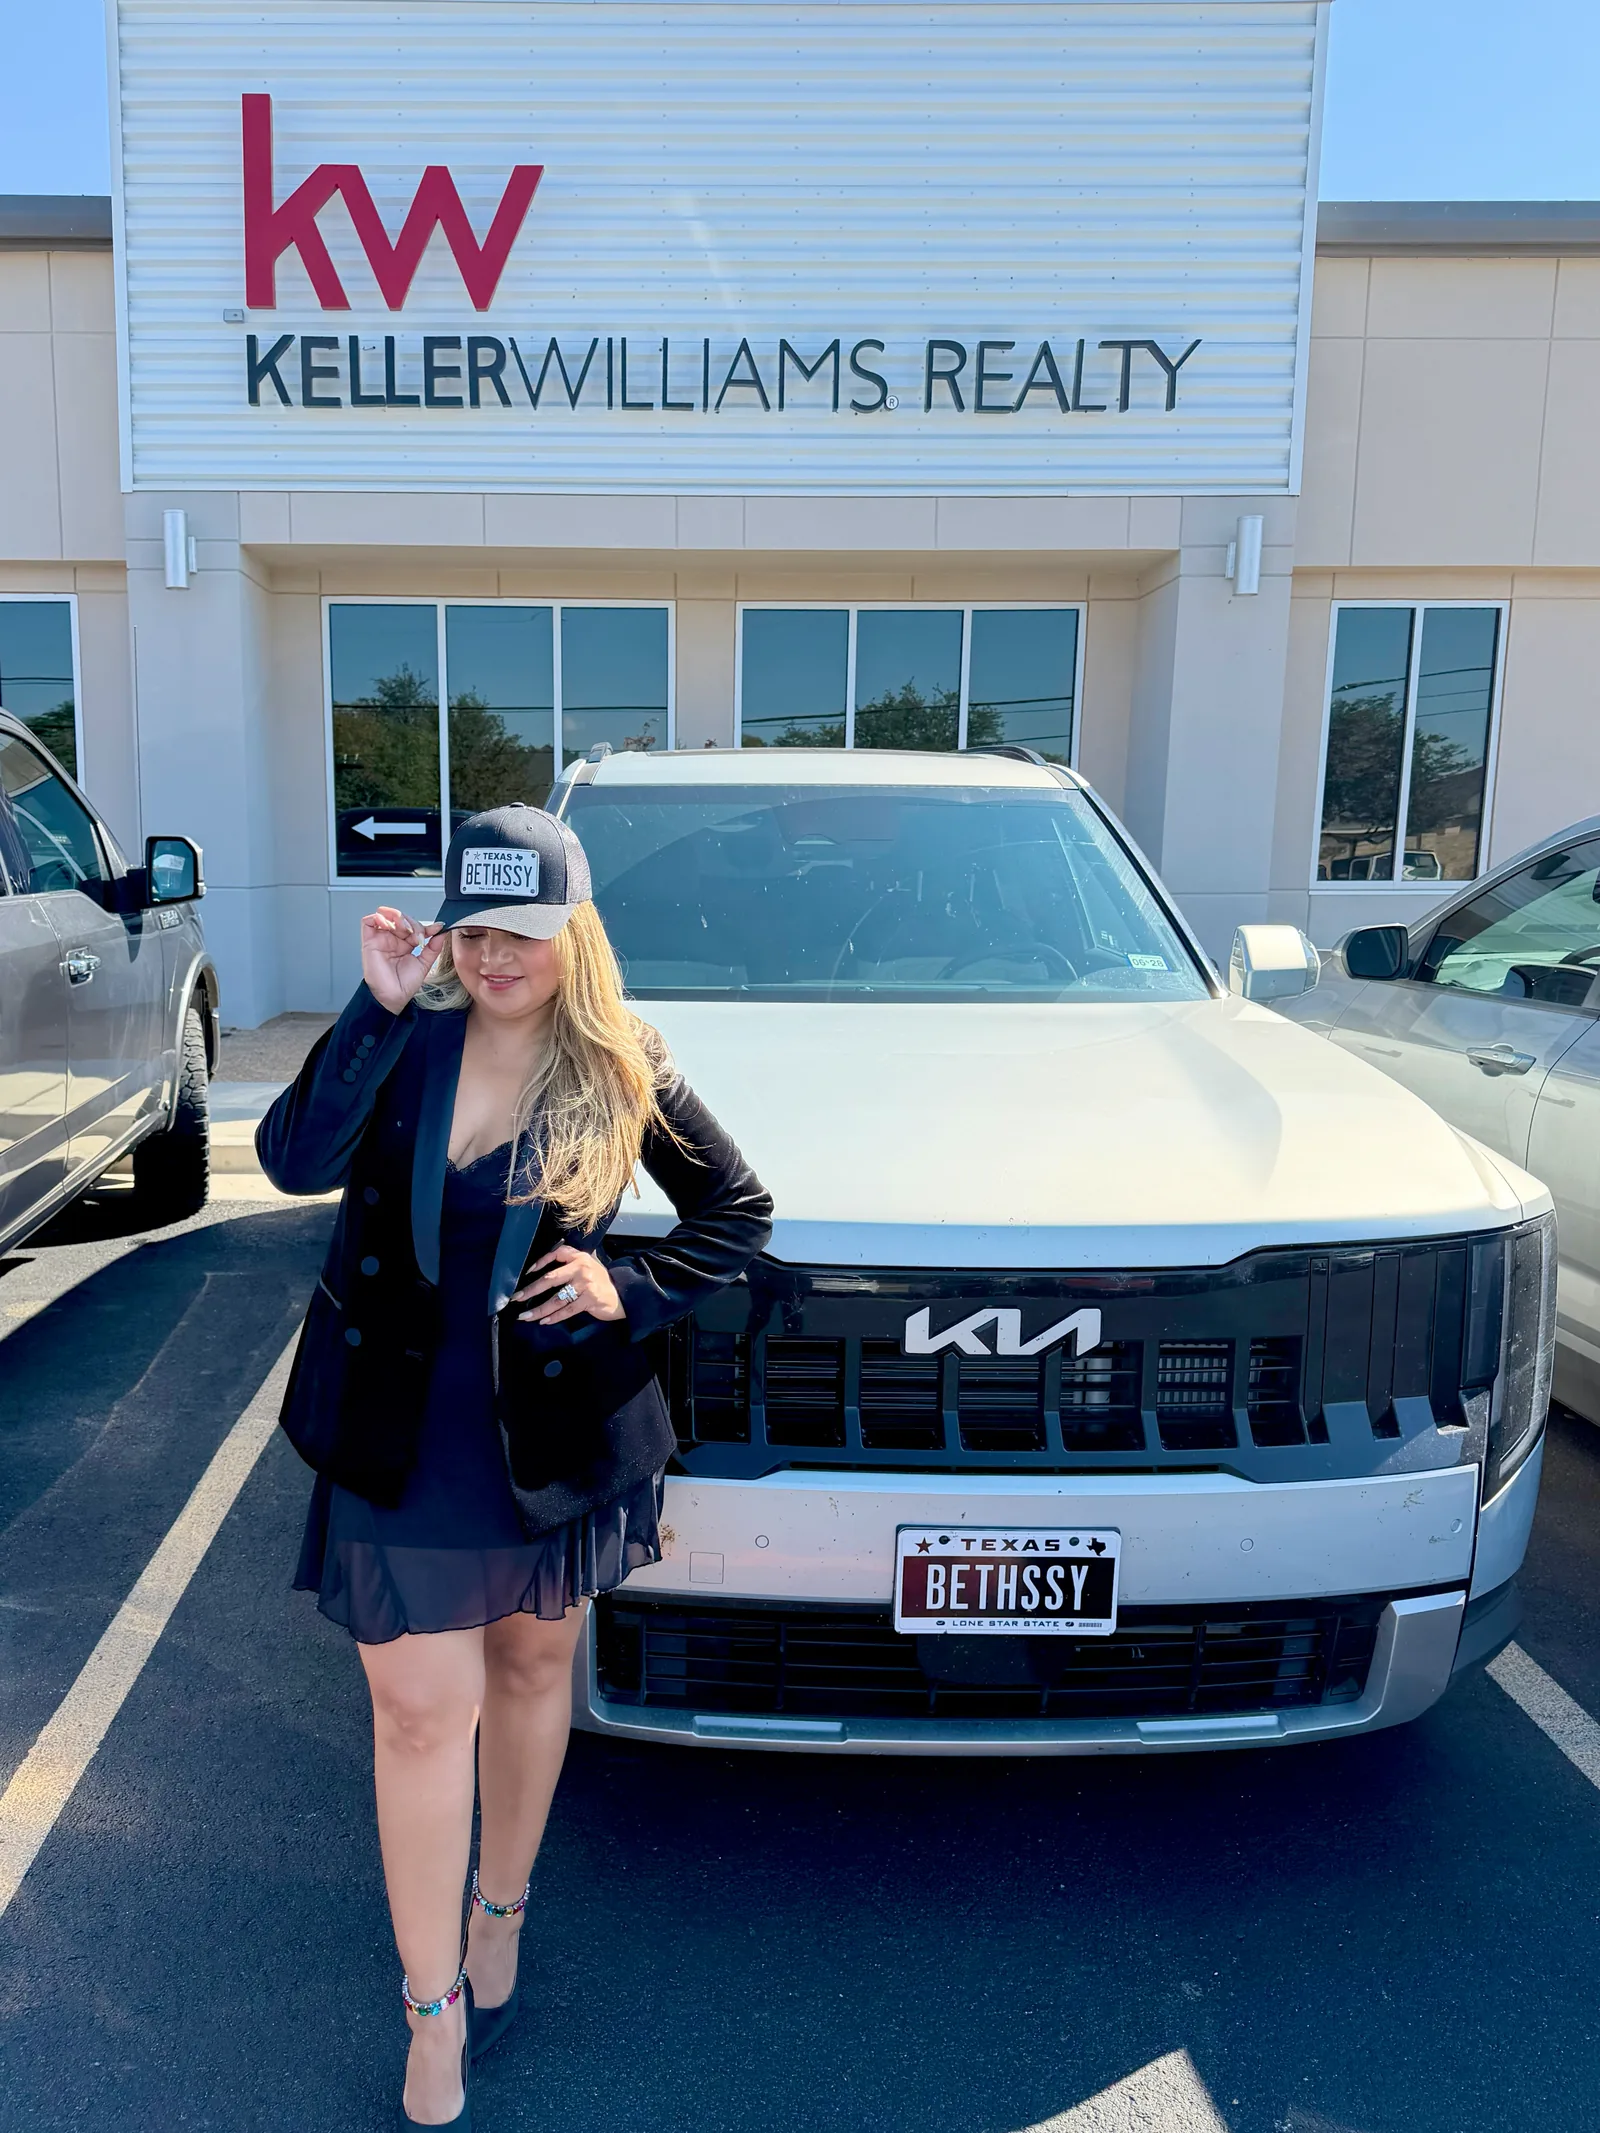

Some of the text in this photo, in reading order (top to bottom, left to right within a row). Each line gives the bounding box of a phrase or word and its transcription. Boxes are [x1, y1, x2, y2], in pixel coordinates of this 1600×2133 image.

[923, 338, 1202, 413] REALTY
[483, 853, 512, 861] TEXAS
[466, 863, 532, 887] BETHSSY
[905, 1306, 1102, 1357] KIA
[960, 1538, 1060, 1551] TEXAS
[926, 1564, 1089, 1611] BETHSSY
